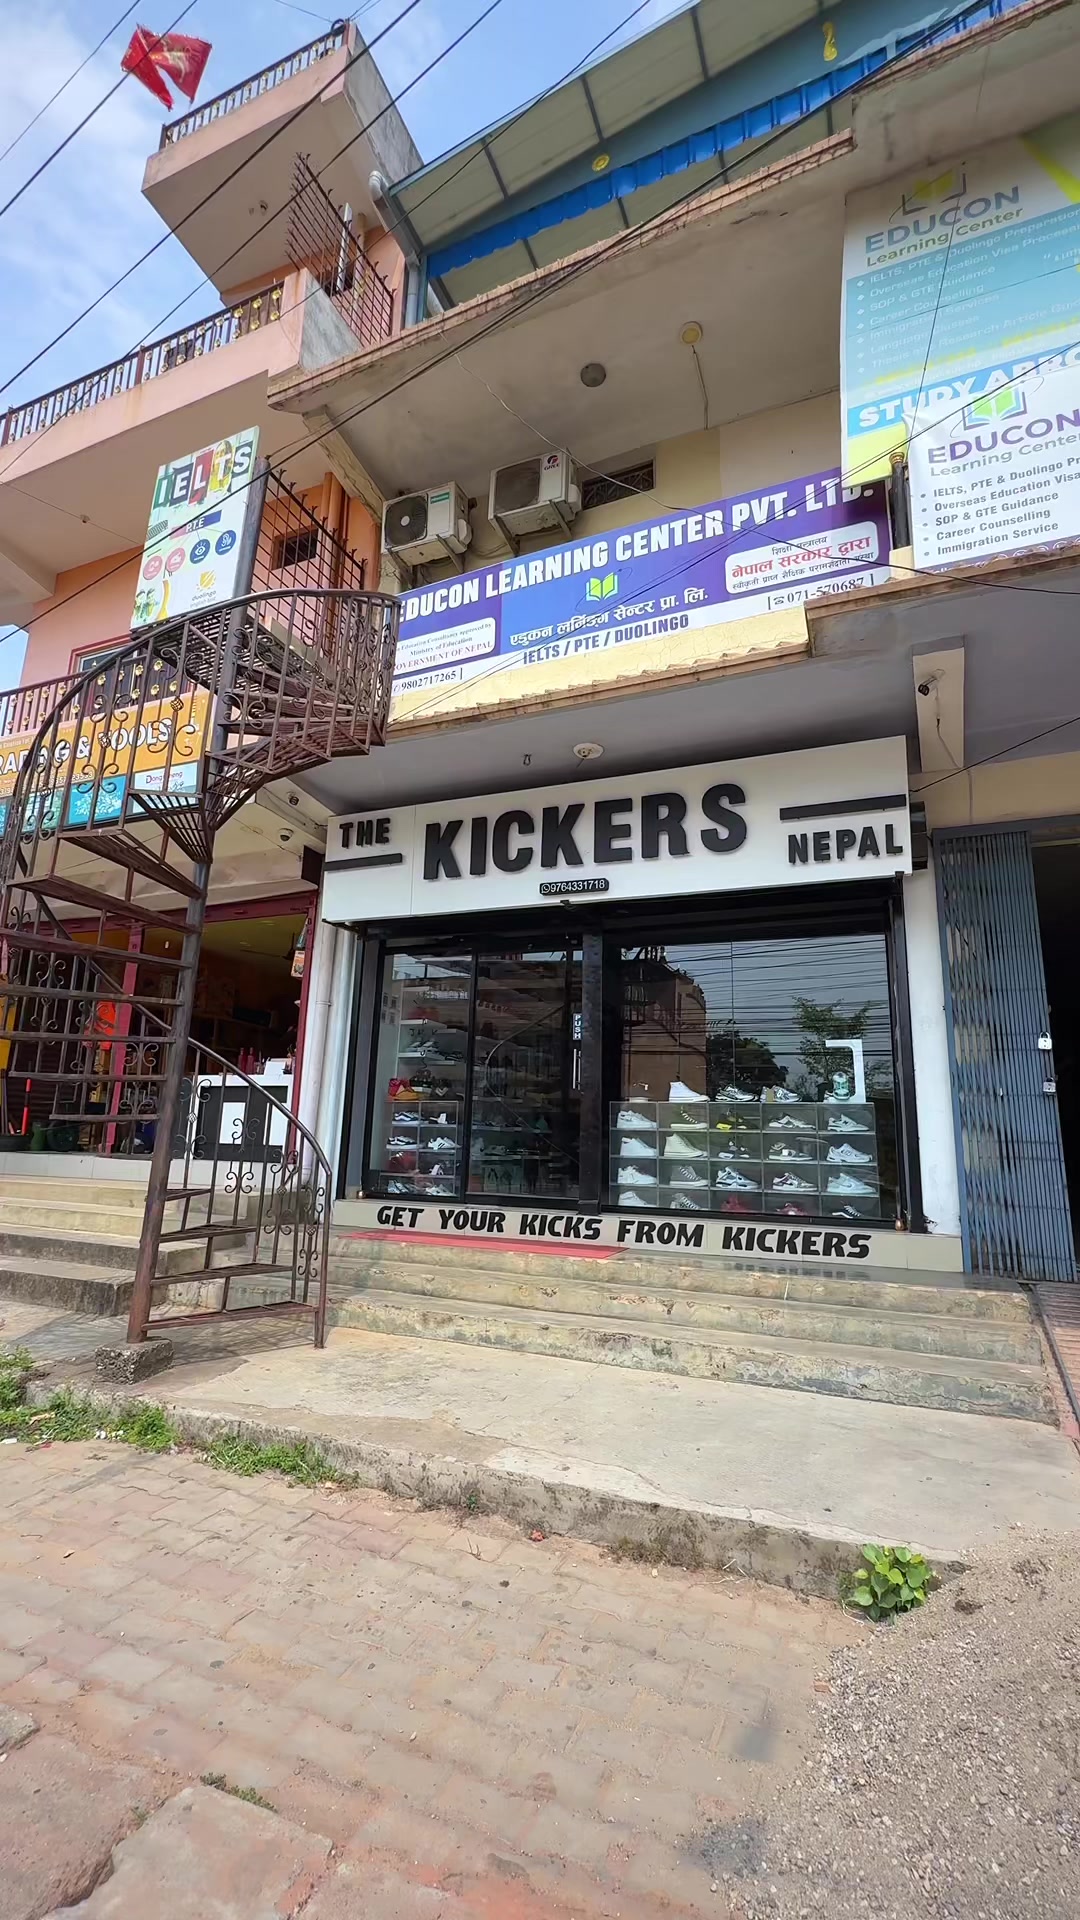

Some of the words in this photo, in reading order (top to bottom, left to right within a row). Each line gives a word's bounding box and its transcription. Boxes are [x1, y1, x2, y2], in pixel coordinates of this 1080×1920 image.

[865, 186, 1020, 253] EDUCON
[867, 232, 949, 266] Learning
[908, 256, 932, 271] PTE
[935, 253, 944, 263] &
[870, 276, 924, 298] Overseas
[927, 255, 988, 279] Education
[991, 244, 1019, 259] Visa
[870, 297, 895, 312] SOP
[899, 292, 908, 303] &
[911, 284, 933, 299] GTE
[939, 266, 995, 291] Guidance
[870, 308, 911, 327] Career
[860, 377, 977, 428] STUDY
[928, 409, 1080, 464] EDUCON
[158, 446, 252, 503] IELTS
[930, 450, 1012, 477] Learning
[934, 485, 967, 497] IELTS,
[971, 478, 993, 491] PTE
[997, 475, 1005, 484] &
[1010, 462, 1063, 481] Duolingo
[935, 495, 986, 512] Overseas
[990, 478, 1050, 501] Education
[1055, 471, 1080, 484] Visa
[935, 514, 958, 526] SOP
[963, 511, 971, 520] &
[976, 505, 998, 517] GTE
[1001, 492, 1059, 512] Guidance
[936, 527, 975, 540] Career
[980, 509, 1050, 531] Counselling
[485, 541, 609, 598] LEARNING
[615, 509, 724, 561] CENTER
[732, 491, 797, 531] PVT.
[937, 535, 1009, 555] Immigration
[1013, 522, 1059, 539] Service
[732, 558, 774, 578] नेपाल
[778, 546, 833, 567] सरकार
[838, 536, 872, 557] द्वारा
[787, 576, 865, 603] 071-570687
[613, 600, 656, 621] सेन्टर
[443, 636, 473, 648] Education
[451, 648, 463, 657] OF
[465, 641, 493, 653] NEPAL
[523, 644, 560, 665] IELTS
[574, 634, 600, 654] PTE
[614, 614, 689, 644] DUOLINGO
[401, 670, 457, 691] 9802717265
[98, 718, 173, 751] OOLS
[339, 817, 391, 849] THE
[423, 783, 747, 880] KICKERS
[788, 824, 903, 864] NEPAL
[551, 880, 605, 893] 9764331718
[377, 1205, 425, 1228] GET
[439, 1208, 506, 1233] YOUR
[519, 1213, 603, 1240] KICKS
[617, 1219, 704, 1247] FROM
[722, 1226, 872, 1259] KICKERS
